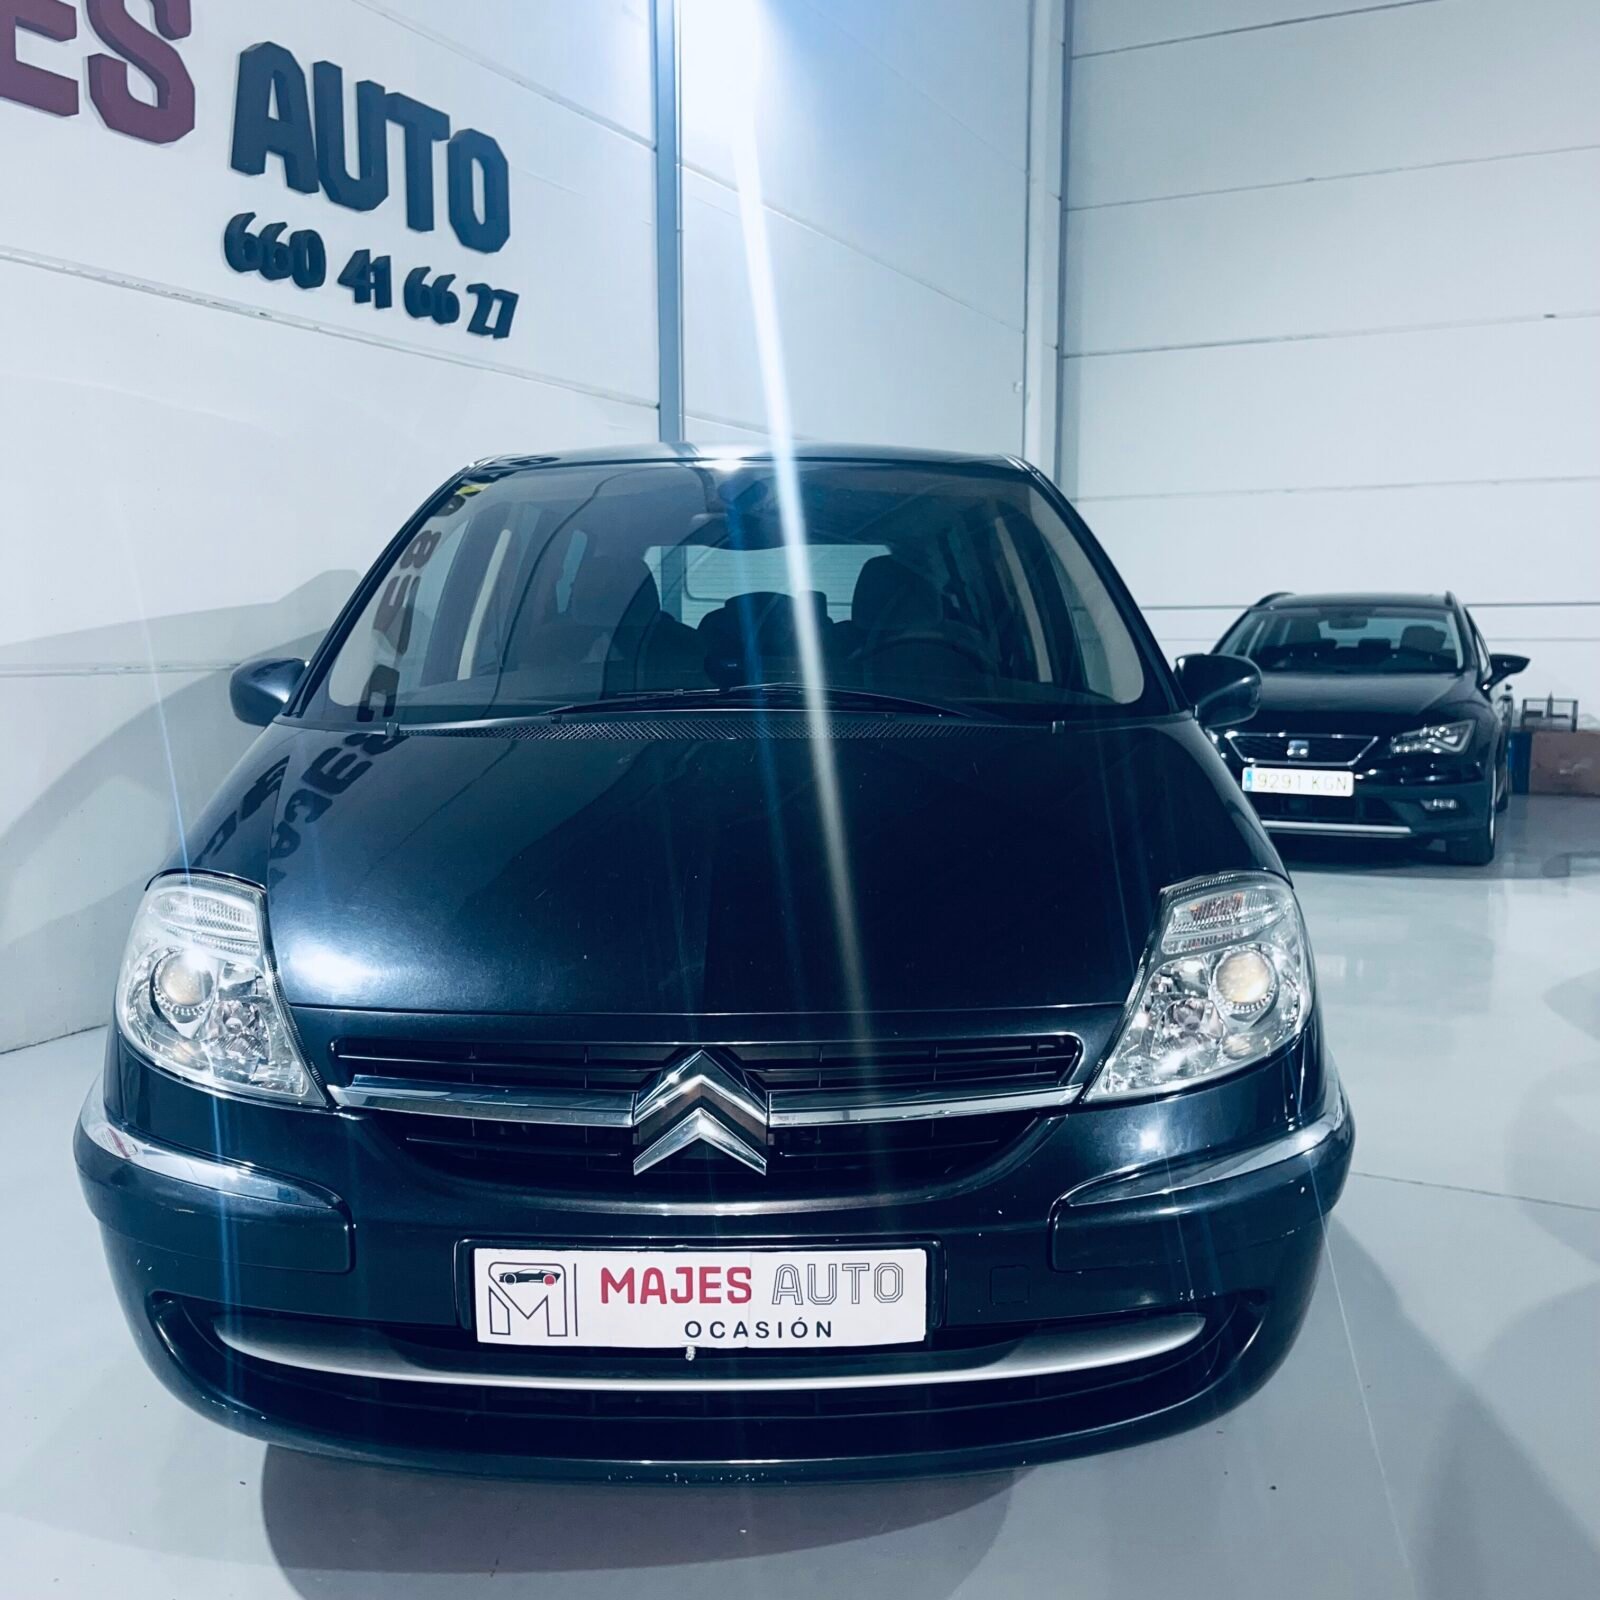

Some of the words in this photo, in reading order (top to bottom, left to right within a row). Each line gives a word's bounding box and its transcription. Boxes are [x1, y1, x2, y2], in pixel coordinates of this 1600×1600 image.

[230, 41, 511, 254] AUTO
[223, 212, 326, 289] 660
[337, 249, 391, 309] 41
[403, 266, 461, 324] 66
[466, 283, 520, 339] 27
[1256, 774, 1302, 791] 9291
[600, 1266, 752, 1304] MAJES
[771, 1262, 904, 1305] AUTO
[684, 1317, 832, 1339] OCASIÓN
